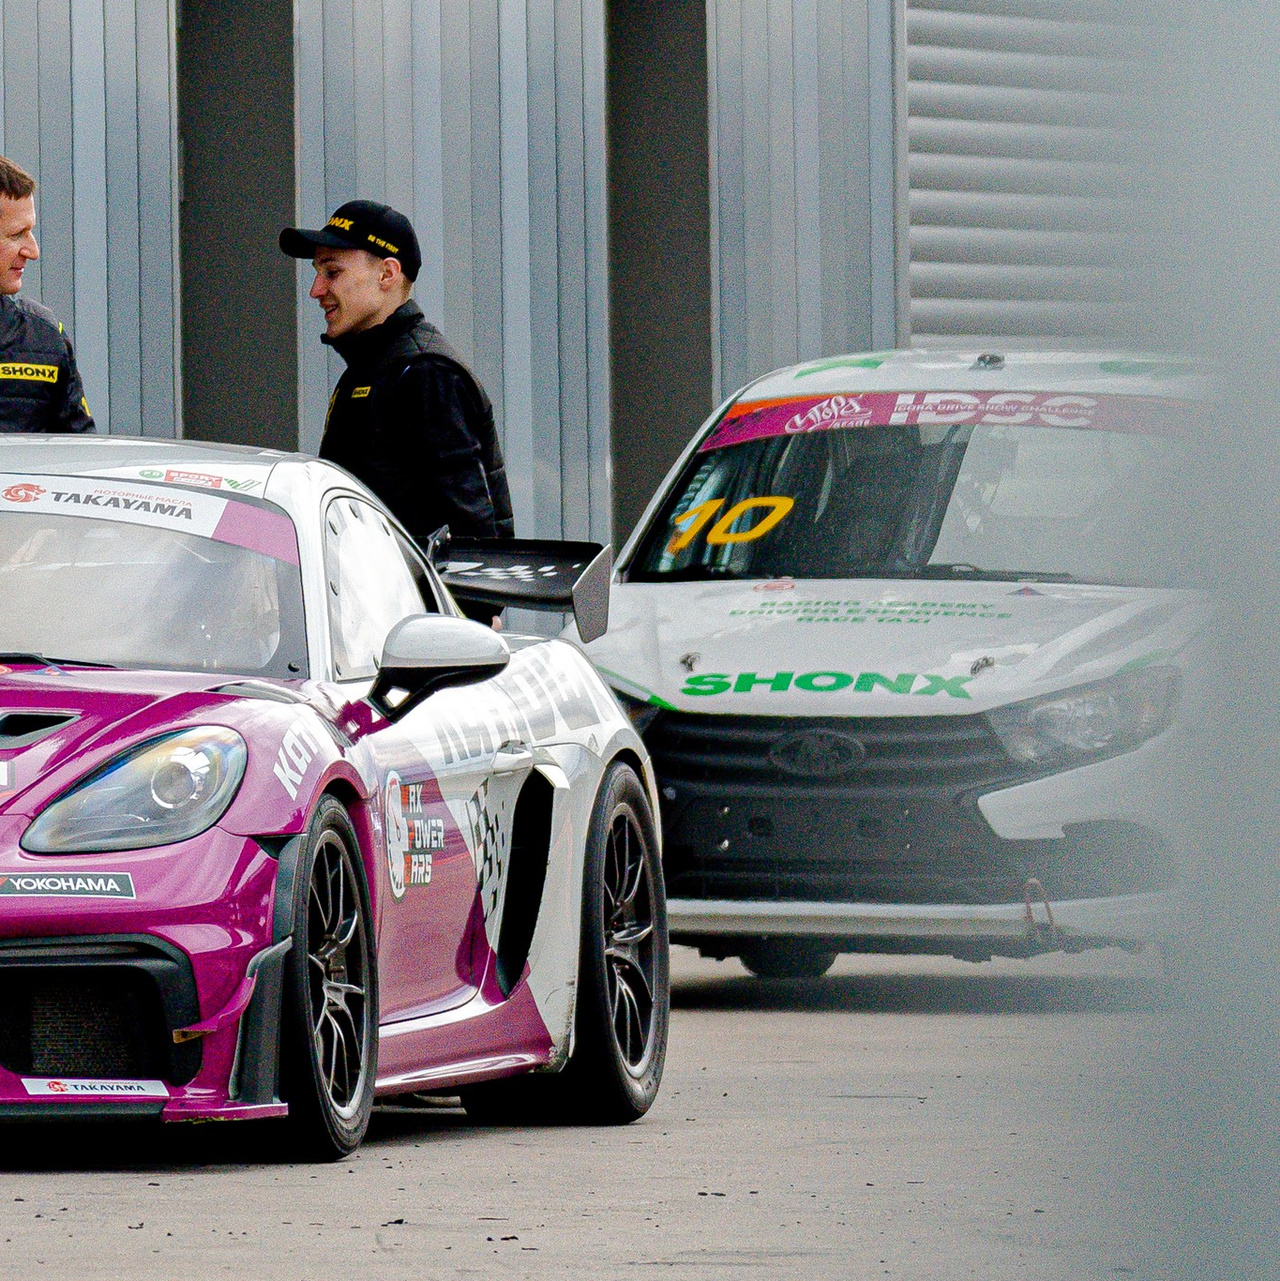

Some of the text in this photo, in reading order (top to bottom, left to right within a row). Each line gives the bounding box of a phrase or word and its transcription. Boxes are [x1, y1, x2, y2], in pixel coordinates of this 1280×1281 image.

[0, 365, 56, 380] SHONX
[889, 390, 1098, 427] IDSC
[51, 491, 193, 520] TAKAYAMA
[94, 488, 193, 507] МОТОРНЫЕ МАСЛА
[667, 496, 795, 556] 10
[679, 669, 974, 700] SHONX
[10, 878, 121, 892] YOKOHAMA
[70, 1084, 146, 1092] TAKAYAMA
